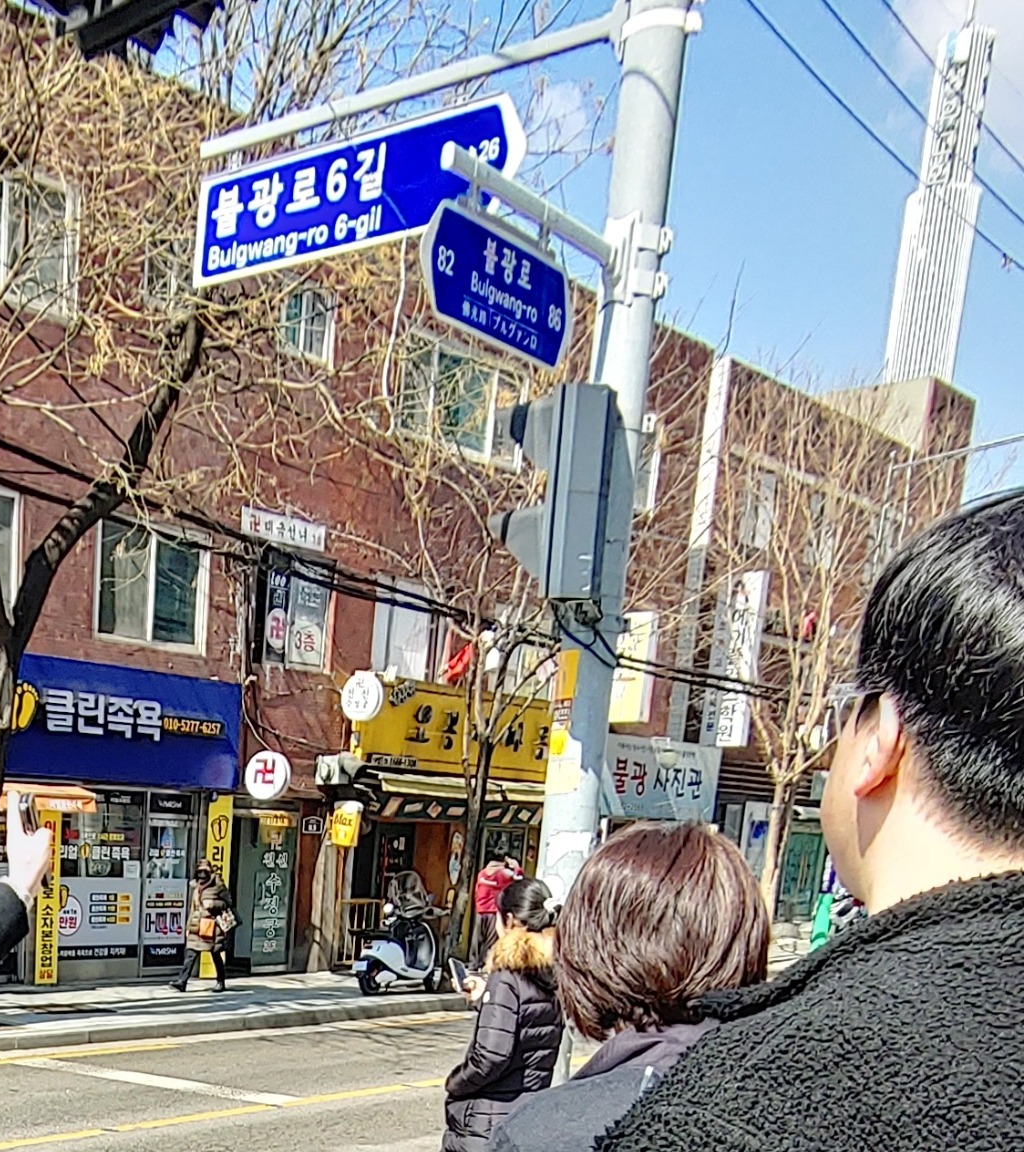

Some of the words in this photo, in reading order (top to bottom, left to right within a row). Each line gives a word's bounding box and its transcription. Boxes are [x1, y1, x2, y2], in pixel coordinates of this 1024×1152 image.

[211, 141, 387, 239] 불광로6길
[207, 220, 329, 272] Bulgwang-ro
[334, 204, 381, 242] 6-gil
[437, 245, 455, 276] 82
[483, 236, 532, 291] 불광로
[470, 270, 538, 324] Bulgwang-ro
[548, 303, 563, 333] 86
[294, 630, 316, 653] 3층
[44, 687, 162, 742] 클린족욕
[613, 756, 648, 797] 불광
[652, 767, 703, 801] 사진관
[333, 813, 353, 827] Max
